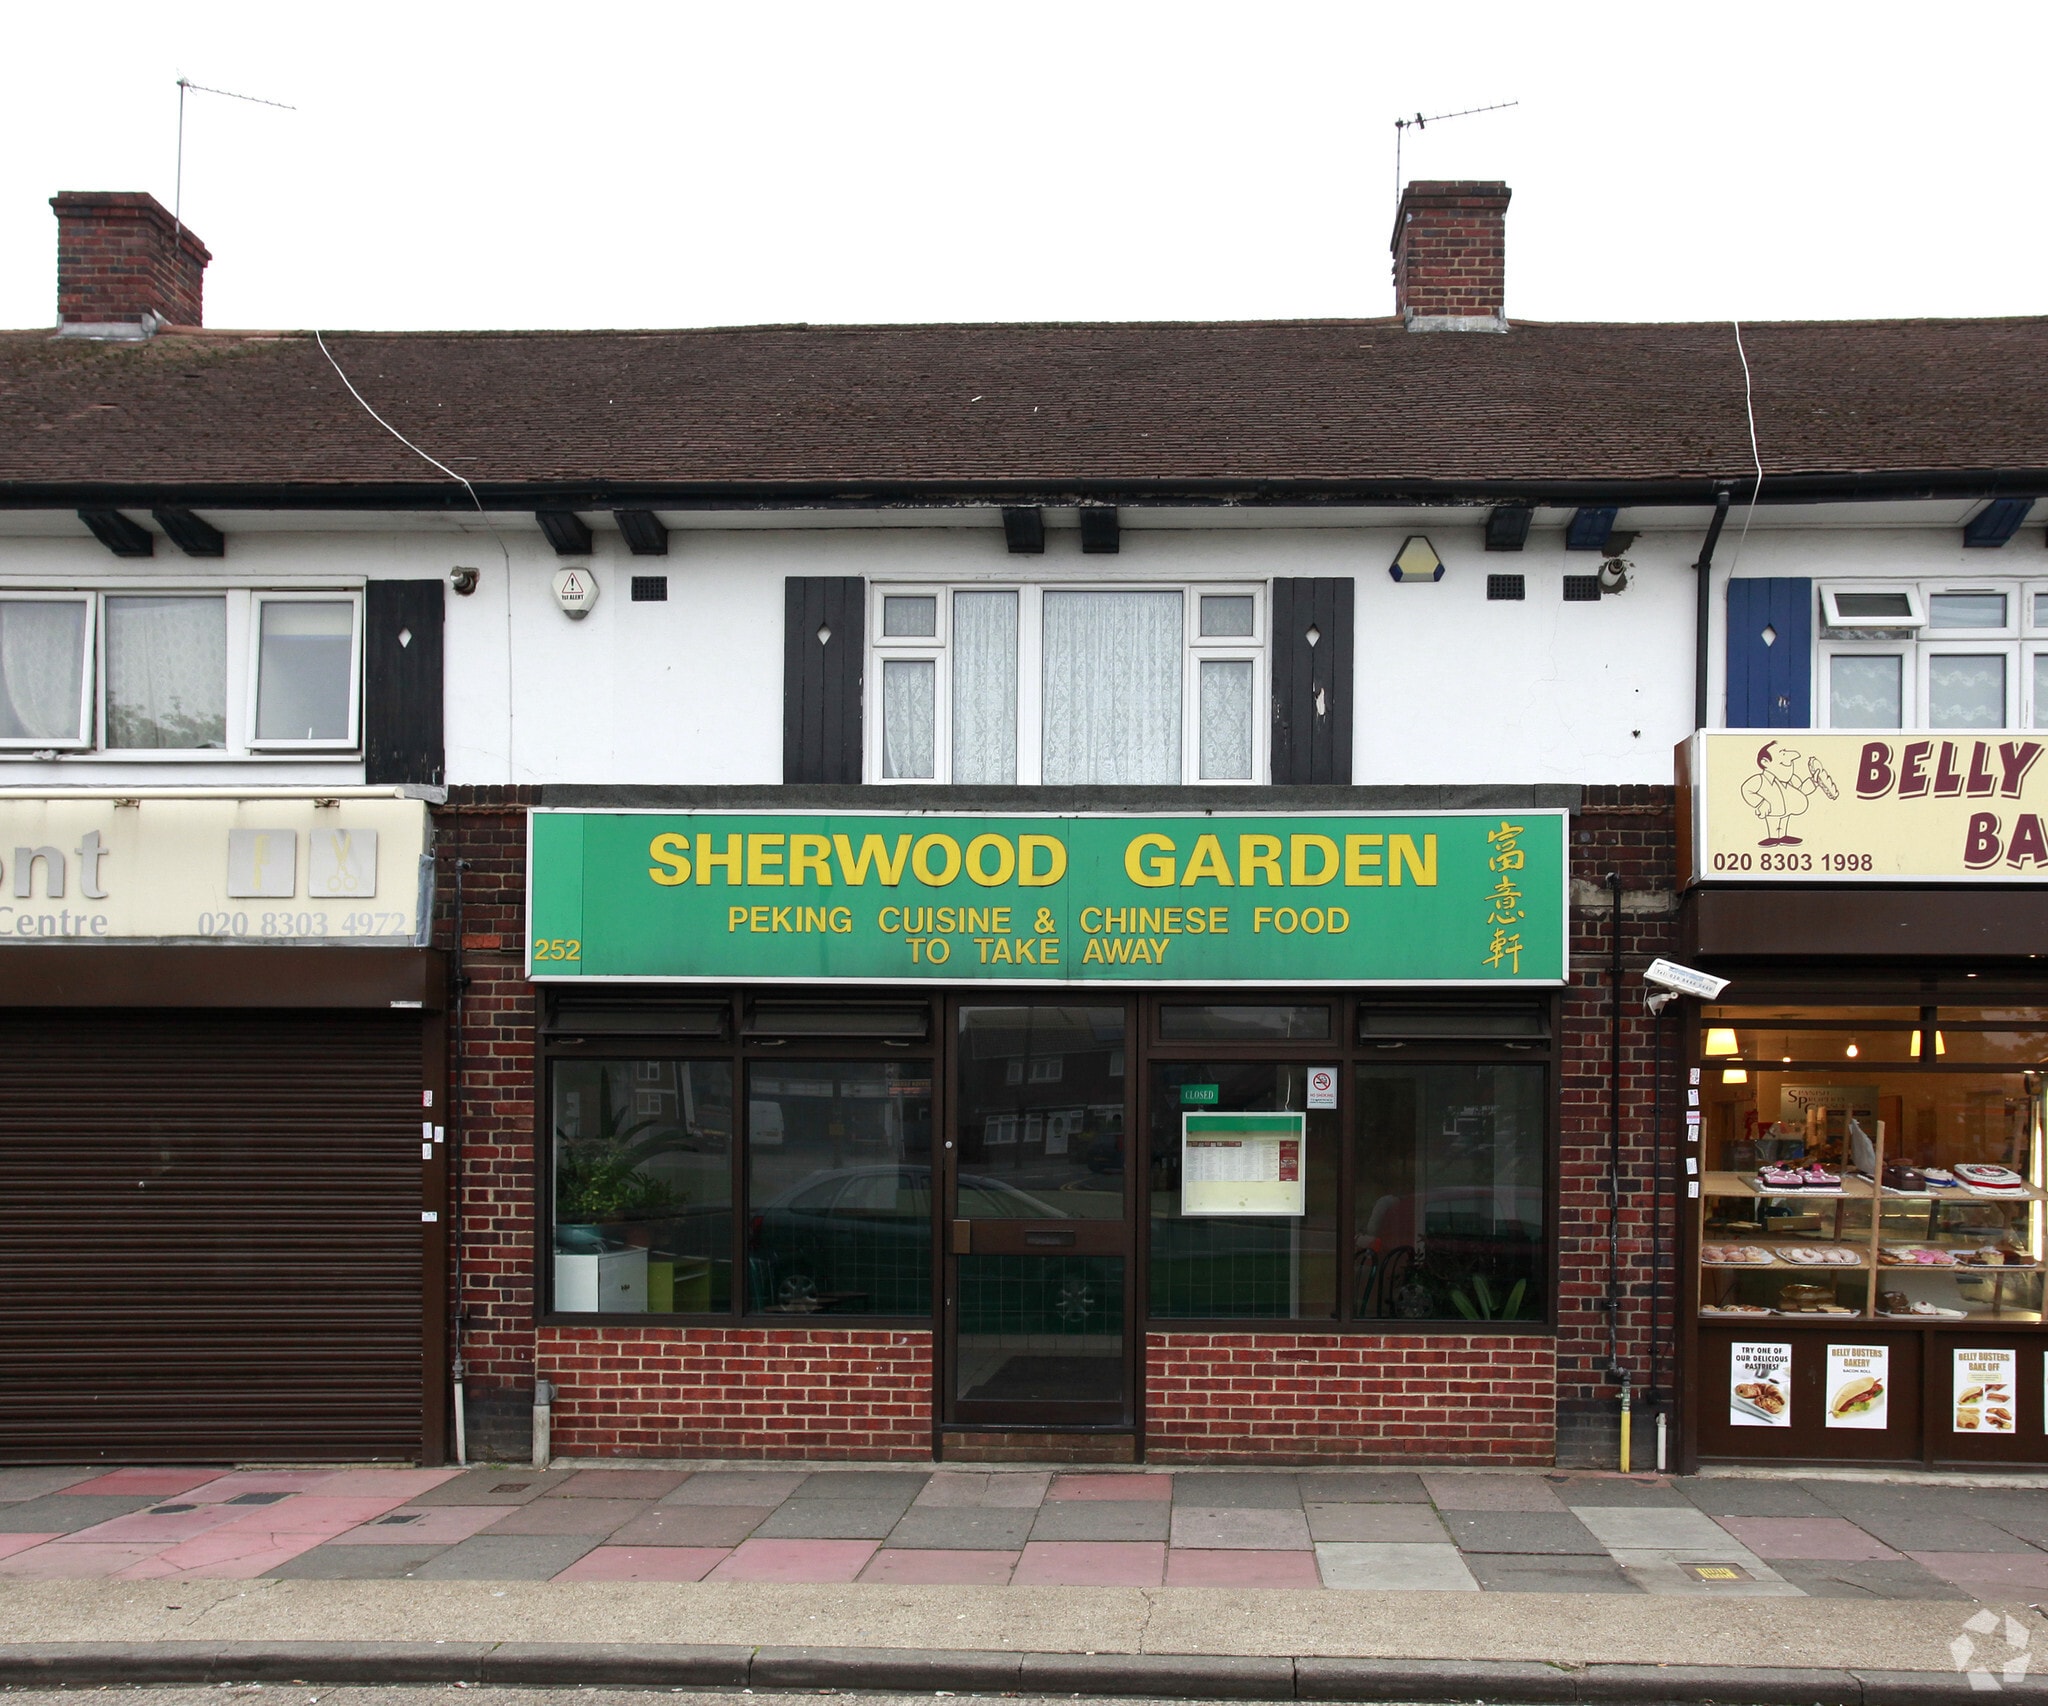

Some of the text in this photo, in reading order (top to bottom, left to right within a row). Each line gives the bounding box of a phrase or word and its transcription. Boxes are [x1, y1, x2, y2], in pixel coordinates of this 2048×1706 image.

[1856, 741, 2045, 800] BELLY
[0, 829, 109, 900] nt
[649, 832, 1438, 887] SHERWOOD GARDEN
[1713, 853, 1873, 871] 020 8303 1998
[1482, 821, 1525, 974] 富意軒
[0, 906, 108, 936] Centre
[198, 912, 406, 936] 020 8303 4972
[728, 906, 1350, 934] PEKING CUISINE & CHINESE FOOD
[534, 938, 581, 961] 252
[905, 937, 1170, 964] TO TAKE AWAY
[1185, 1090, 1214, 1100] CLOSED
[1753, 1355, 1788, 1363] DELICIOUS
[1831, 1348, 1883, 1358] BELLY BUSTERS
[1843, 1358, 1870, 1367] BAKERY
[1958, 1352, 2010, 1362] BELLY BUSTERS
[1744, 1362, 1779, 1371] PASTRIES!
[1968, 1362, 2000, 1371] BAKE OFF
